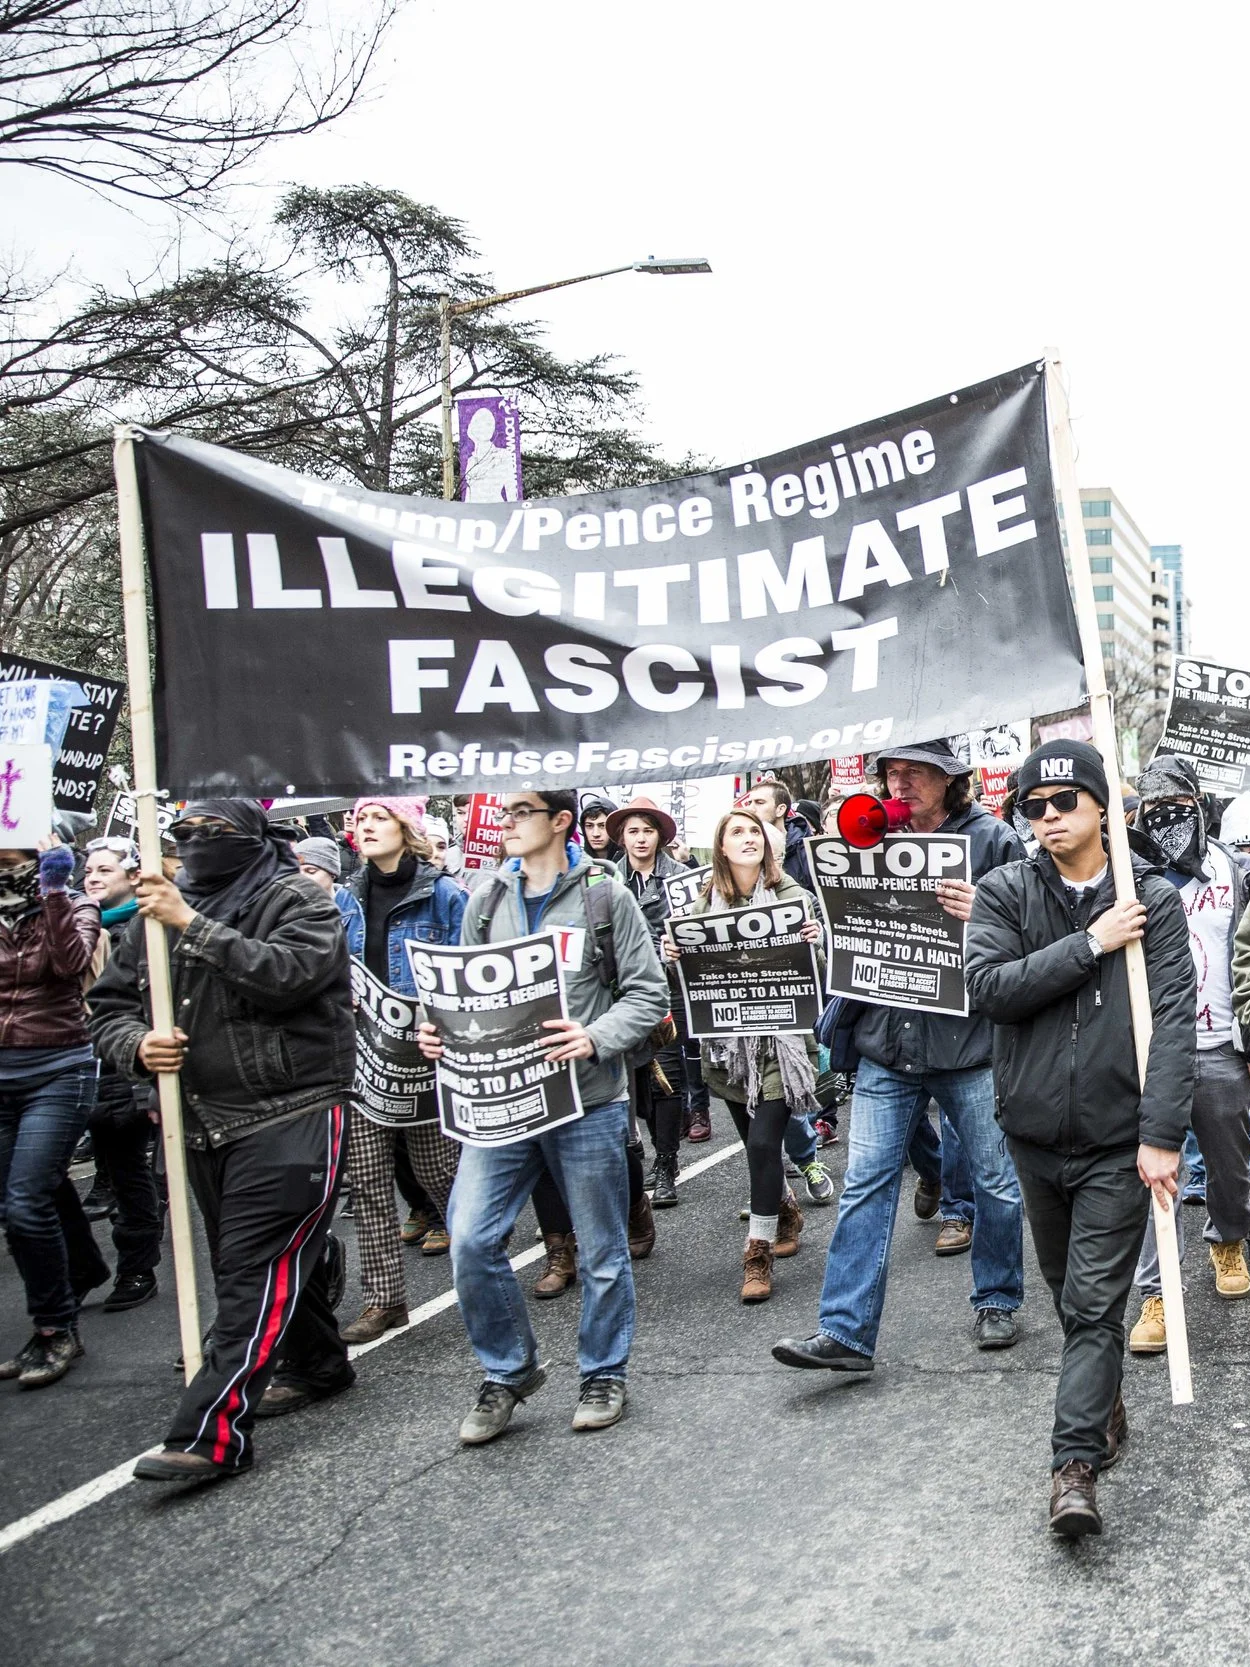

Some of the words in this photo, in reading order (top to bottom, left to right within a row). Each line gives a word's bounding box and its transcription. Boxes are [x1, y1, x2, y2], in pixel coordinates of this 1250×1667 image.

[296, 478, 713, 553] Trump/Pence
[729, 428, 937, 519] Regime
[201, 467, 1037, 626] ILLEGITIMATE
[388, 617, 898, 714] FASCIST
[83, 682, 118, 710] STAY
[1175, 686, 1191, 699] THE
[1192, 689, 1247, 709] TRUMP-PENCE
[1178, 723, 1198, 733] Take
[1200, 727, 1209, 736] to
[1210, 729, 1226, 739] the
[390, 717, 894, 778] RefuseFascism.org
[1160, 736, 1192, 753] BRING
[1193, 742, 1209, 756] DC
[1211, 746, 1226, 760] TO
[1225, 750, 1234, 762] A
[1040, 757, 1074, 778] NO!
[815, 841, 964, 877] STOP
[818, 875, 839, 888] THE
[840, 876, 918, 891] TRUMP-PENCE
[675, 906, 803, 945] STOP
[845, 915, 872, 926] Take
[875, 918, 887, 929] to
[889, 920, 907, 931] the
[910, 922, 949, 939] Streets
[701, 937, 767, 953] TRUMP-PENCE
[770, 932, 802, 948] REGIM
[833, 934, 872, 954] BRING
[874, 940, 891, 957] DC
[894, 943, 911, 960] TO
[913, 947, 924, 962] A
[927, 948, 962, 969] HALT!
[413, 943, 554, 995] STOP
[699, 973, 725, 981] Take
[741, 970, 758, 978] the
[761, 969, 799, 977] Streets
[854, 963, 877, 984] NO!
[510, 979, 558, 1006] REGIME
[689, 988, 727, 1001] BRING
[730, 987, 747, 999] DC
[749, 986, 766, 998] TO
[769, 986, 779, 997] A
[780, 984, 815, 997] HALT!
[714, 1007, 738, 1022] NO!
[496, 1040, 545, 1060] Street
[386, 1062, 428, 1073] Streets
[374, 1073, 388, 1090] TO
[390, 1082, 400, 1093] A
[403, 1079, 437, 1093] HALT
[480, 1075, 507, 1095] TO
[509, 1072, 524, 1090] A
